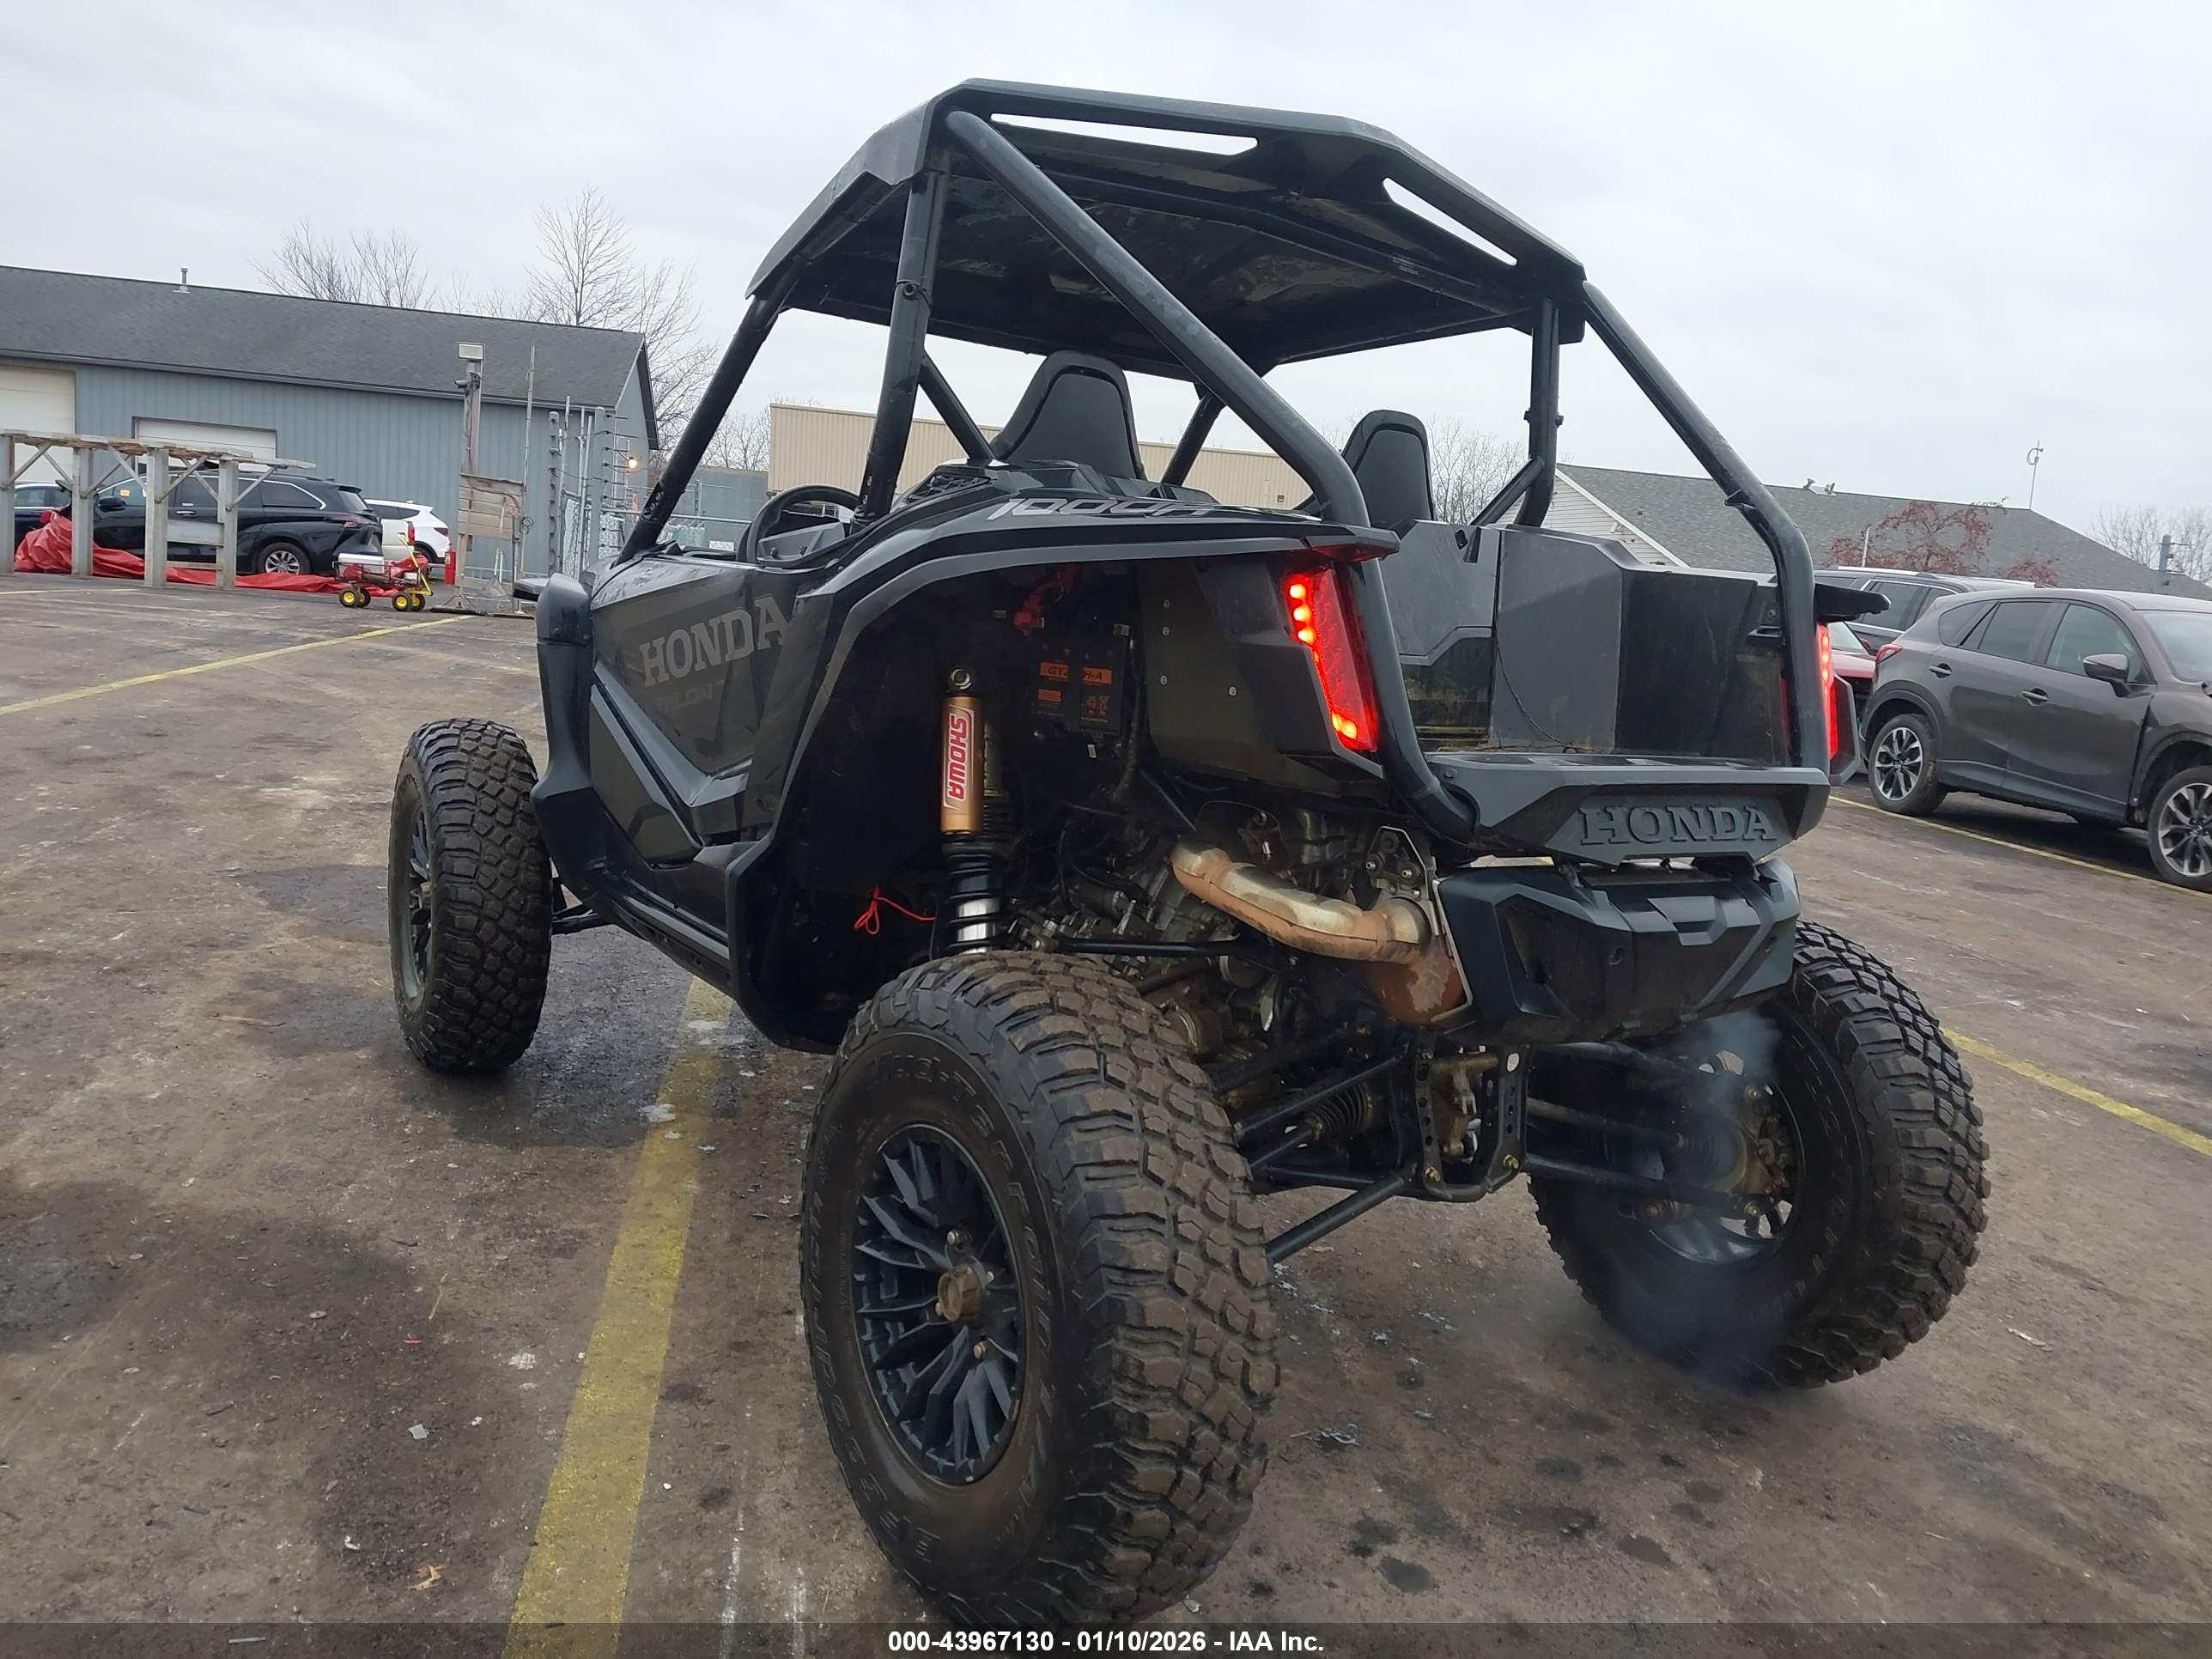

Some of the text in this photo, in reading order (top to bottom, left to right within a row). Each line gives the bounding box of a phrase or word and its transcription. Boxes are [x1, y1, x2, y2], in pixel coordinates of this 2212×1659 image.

[639, 594, 789, 688] HONDA
[947, 713, 969, 801] SHOWA
[1579, 804, 1778, 845] HONDA
